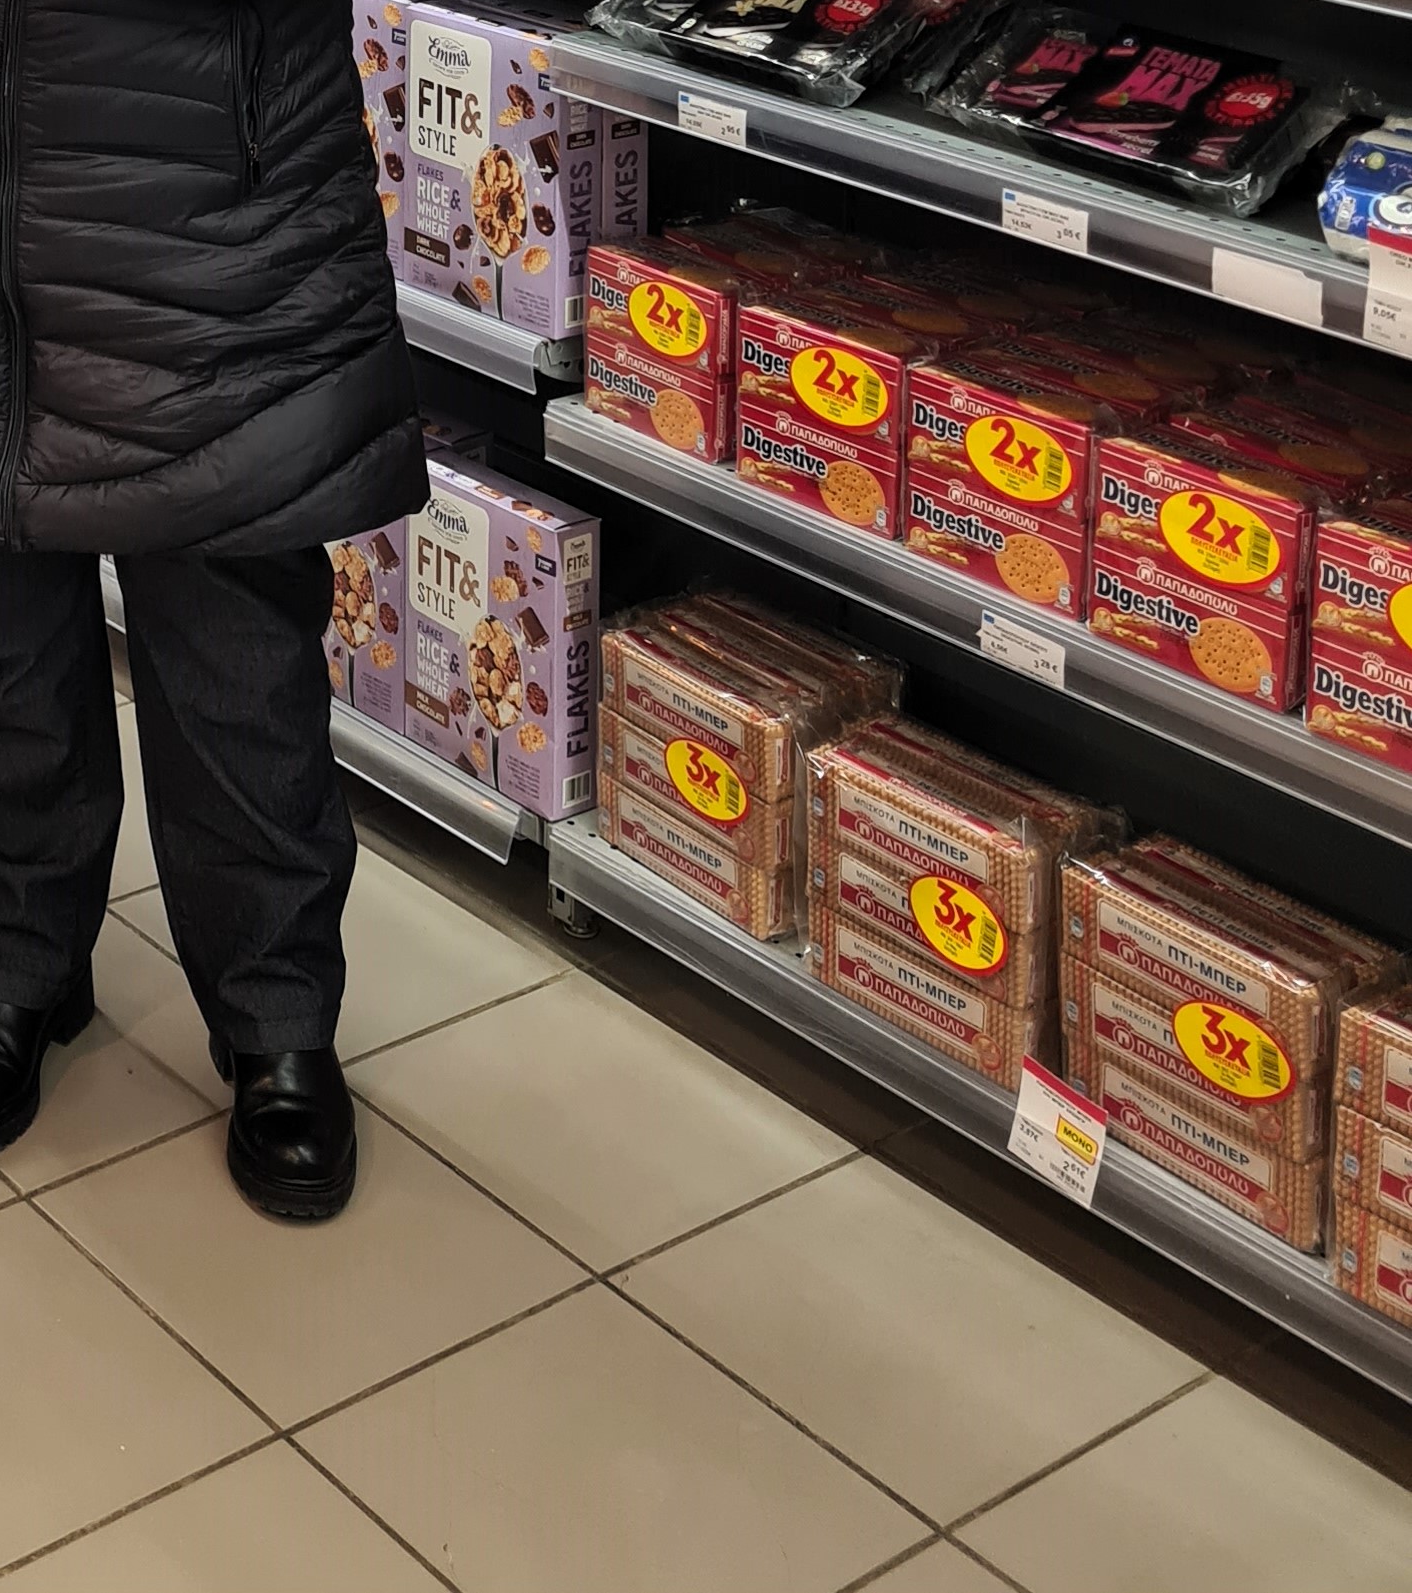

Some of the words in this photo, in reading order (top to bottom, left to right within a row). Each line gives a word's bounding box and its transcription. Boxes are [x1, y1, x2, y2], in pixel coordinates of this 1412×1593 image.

[428, 35, 473, 67] Emma
[1144, 46, 1223, 83] ΓΕΜΑΤΑ
[418, 77, 483, 140] FIT&
[1119, 65, 1208, 111] MAX
[418, 125, 457, 158] STYLE
[417, 163, 444, 183] FLAKES
[416, 199, 451, 225] WHOLE
[417, 215, 449, 241] WHEAT
[569, 160, 593, 277] FLAKES
[416, 245, 447, 264] CHOCOLATE
[646, 284, 684, 334] 2x
[590, 356, 657, 405] Digestive
[813, 349, 861, 403] 2x
[742, 425, 828, 477] Digestive
[989, 418, 1042, 476] 2x
[426, 498, 470, 537] Emma
[912, 493, 1005, 550] Digestive
[1186, 494, 1245, 558] 2x
[417, 535, 483, 608] FIT&
[417, 585, 456, 621] STYLE
[1097, 571, 1199, 634] Digestive
[417, 620, 444, 643] FLAKES
[416, 657, 450, 687] WHOLE
[416, 674, 449, 702] WHEAT
[416, 701, 446, 725] CHOCOLATE
[566, 639, 589, 759] FLAKES
[672, 692, 729, 732] ΠΤΙ-ΜΠΕΡ
[1316, 665, 1412, 731] Digestiv
[686, 741, 720, 796] 3x
[667, 829, 723, 871] ΠΤΙ-ΜΠΕΡ
[899, 820, 969, 863] ΠΤΙ-ΜΠΕΡ
[934, 879, 976, 944] 3x
[898, 967, 967, 1012] ΠΤΙ-ΜΠΕΡ
[1167, 944, 1247, 995] ΠΤΙ-ΜΠΕΡ
[1200, 1004, 1251, 1070] 3x
[1171, 1112, 1250, 1166] ΠΤΙ-ΜΠΕΡ
[1062, 1160, 1070, 1171] 2
